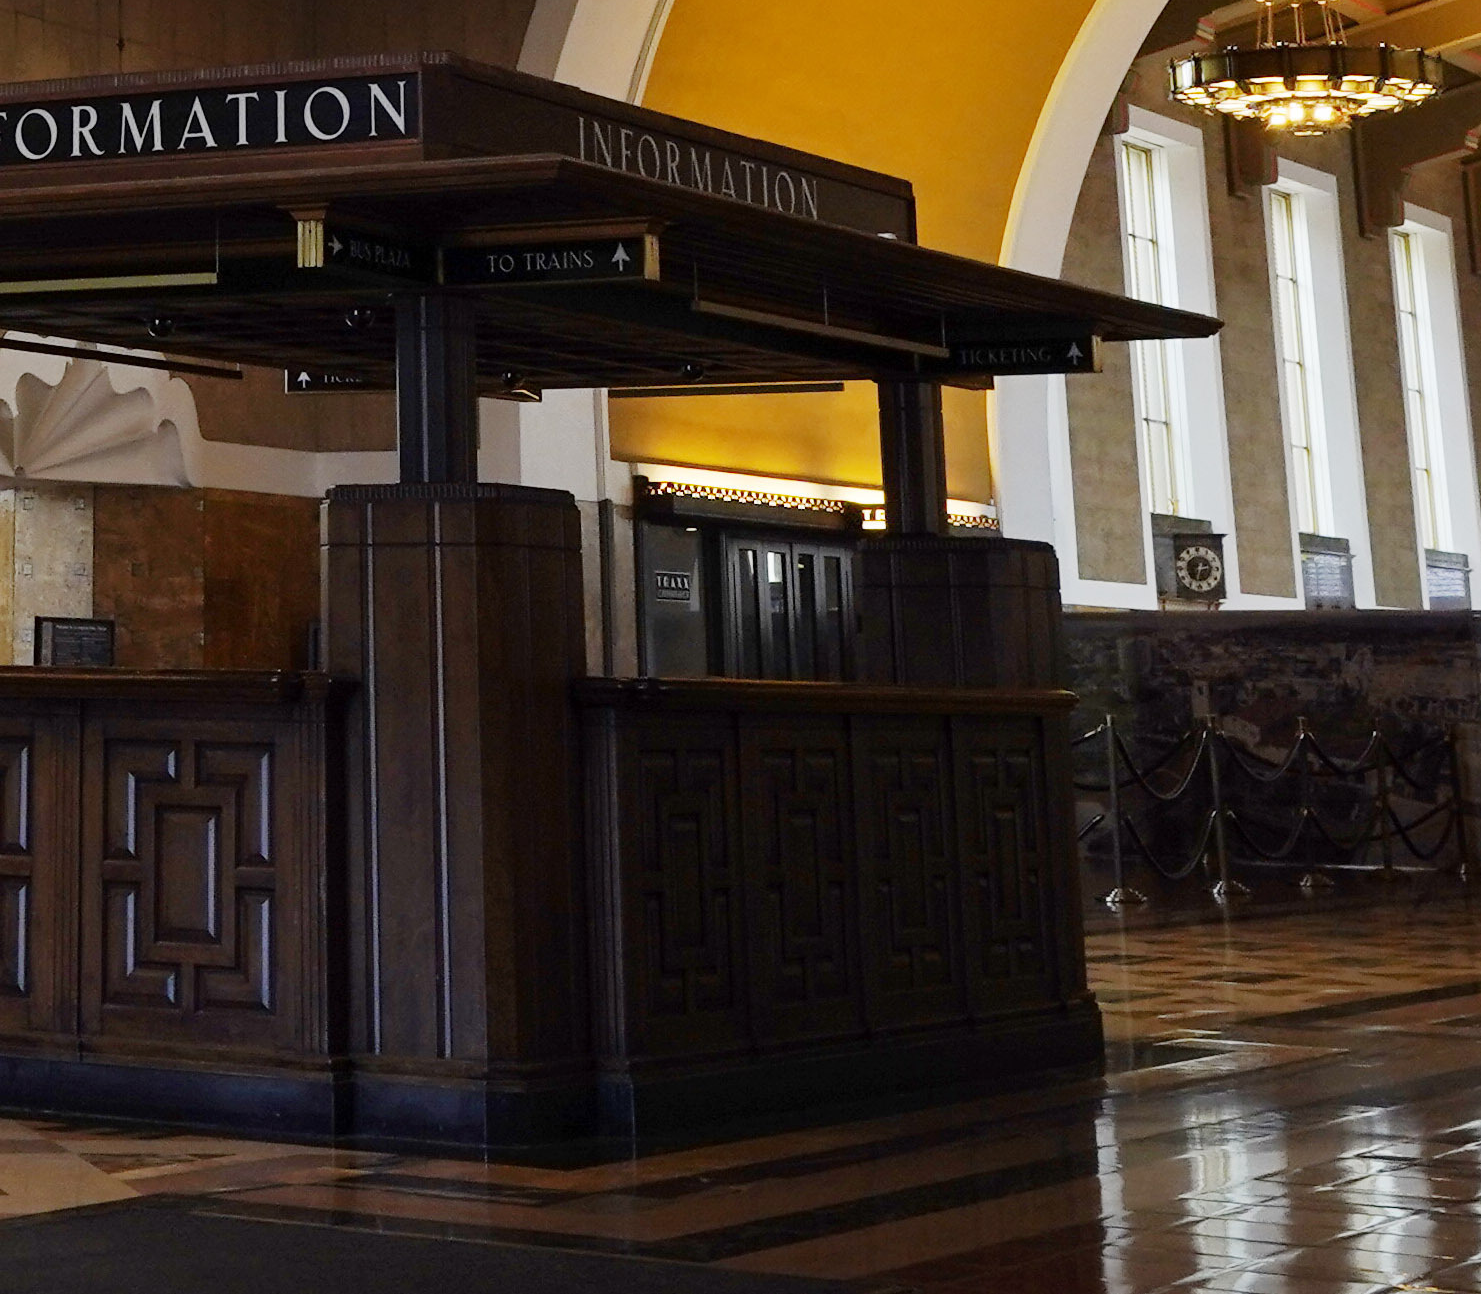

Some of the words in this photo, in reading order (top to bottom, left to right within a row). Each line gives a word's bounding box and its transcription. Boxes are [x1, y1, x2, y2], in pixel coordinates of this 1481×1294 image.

[577, 116, 819, 221] INFORMATION
[489, 253, 515, 273] TO
[524, 249, 594, 272] TRAINS
[959, 347, 1052, 365] TICKETING
